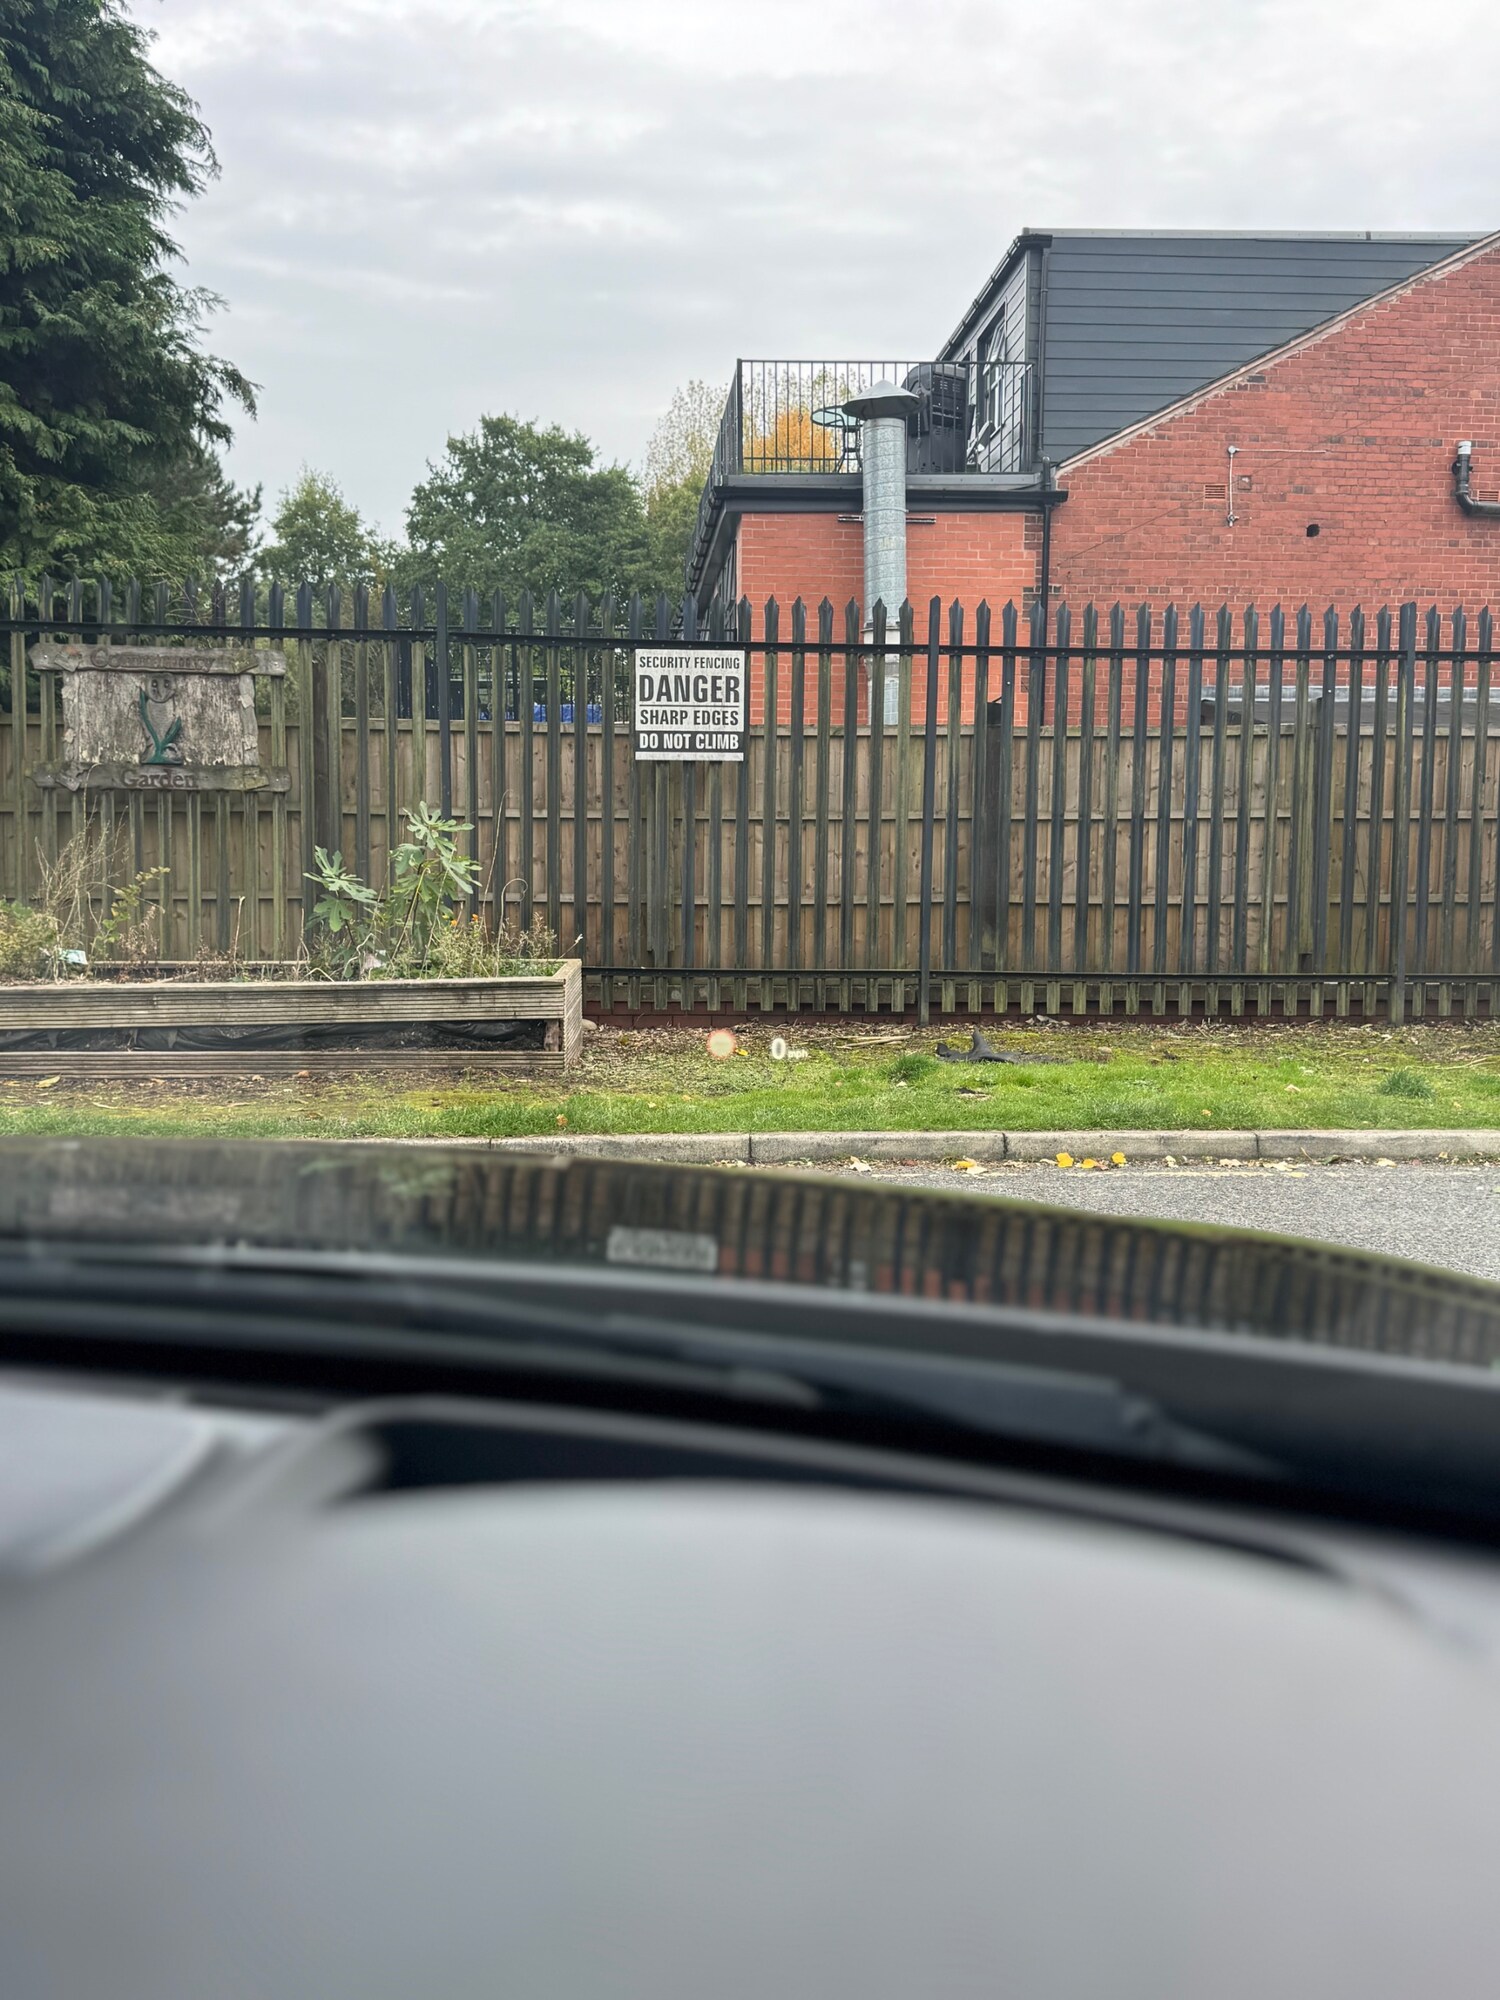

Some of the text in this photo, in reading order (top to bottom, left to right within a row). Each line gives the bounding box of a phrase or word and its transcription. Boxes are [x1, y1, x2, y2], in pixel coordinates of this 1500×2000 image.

[639, 656, 740, 669] SECURITY FENCING
[639, 674, 740, 703] DANGER
[640, 709, 739, 726] SHARP EDGES
[639, 733, 739, 750] DO NOT CLIMB
[121, 767, 199, 788] Garden
[771, 1037, 808, 1060] 0 mph
